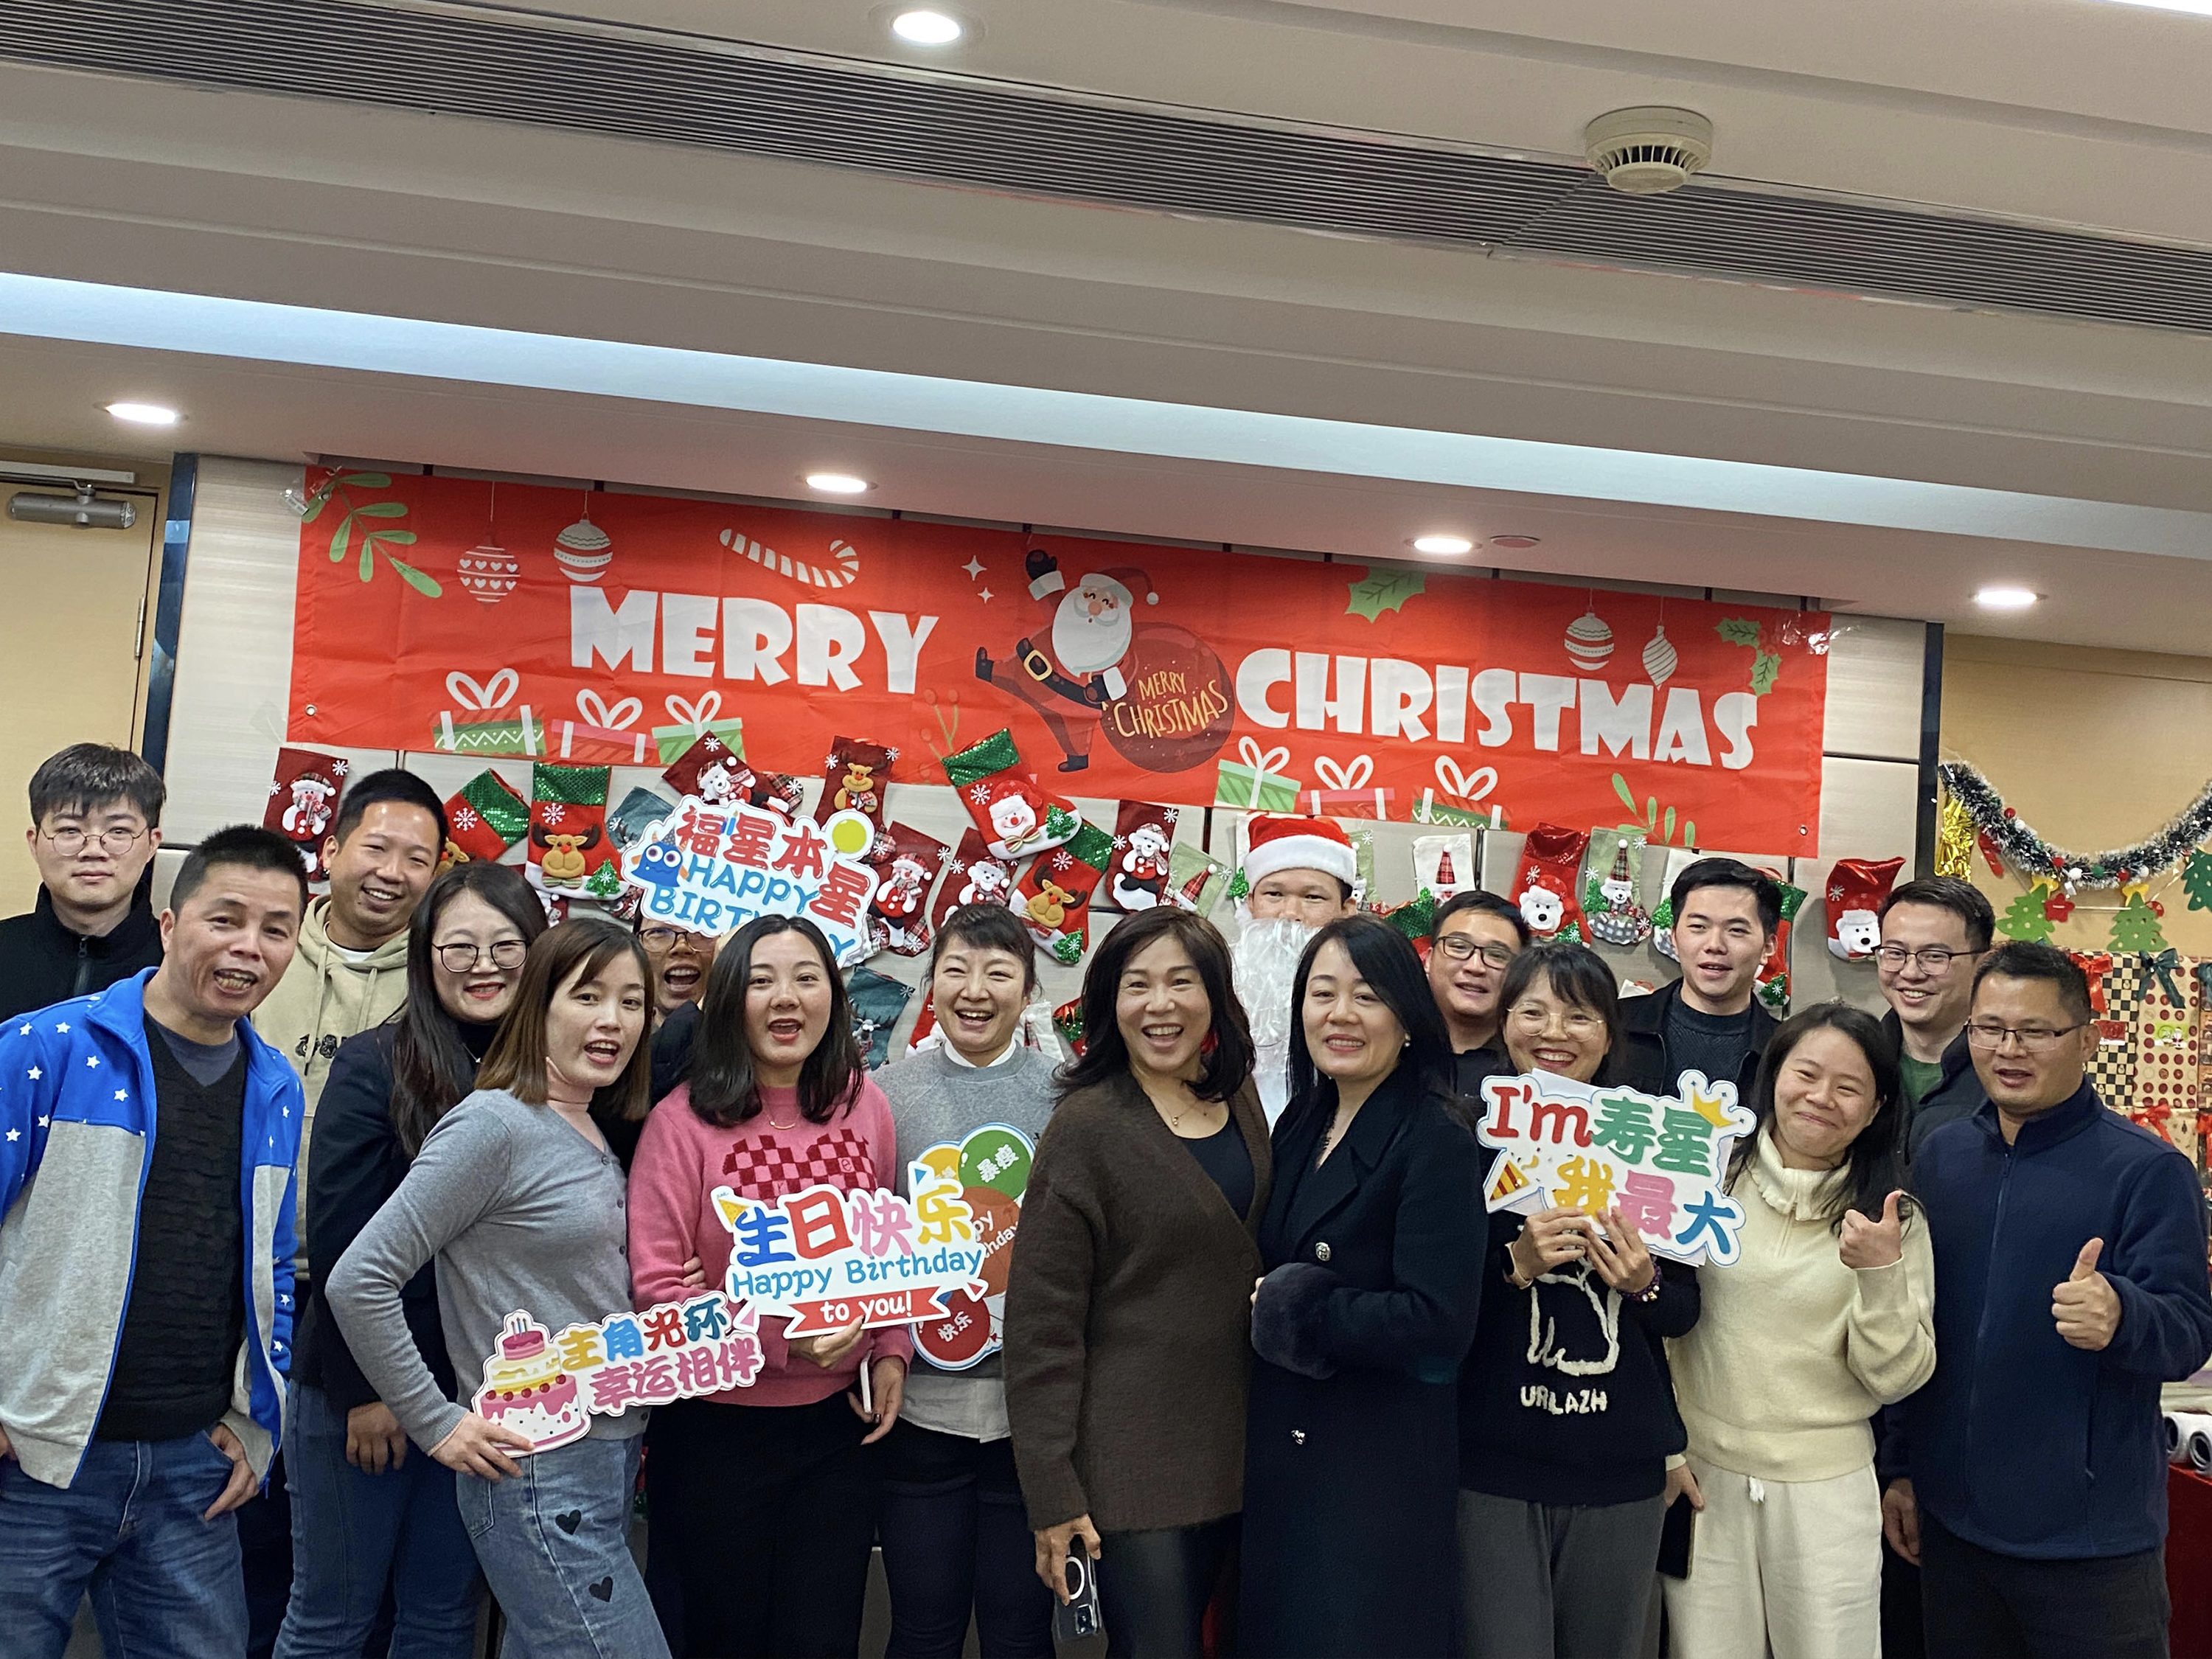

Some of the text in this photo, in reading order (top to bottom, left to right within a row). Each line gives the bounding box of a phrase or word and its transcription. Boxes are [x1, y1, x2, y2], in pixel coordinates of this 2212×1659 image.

[570, 585, 1757, 770] MERRY CHRISTMAS
[1138, 670, 1187, 700] MERRY
[1113, 679, 1228, 739] CHRISTMAS
[676, 804, 870, 930] 福星本星
[687, 854, 820, 914] HAPPY
[736, 1184, 973, 1267] 生日快乐
[1553, 1155, 1736, 1255] 我最大
[732, 1246, 983, 1300] Happy Birthday
[558, 1298, 728, 1371] 主角光环
[819, 1290, 913, 1324] to you!
[937, 1311, 973, 1342] 快乐
[591, 1338, 759, 1410] 幸运相伴
[1520, 1385, 1607, 1415] URLAZH
